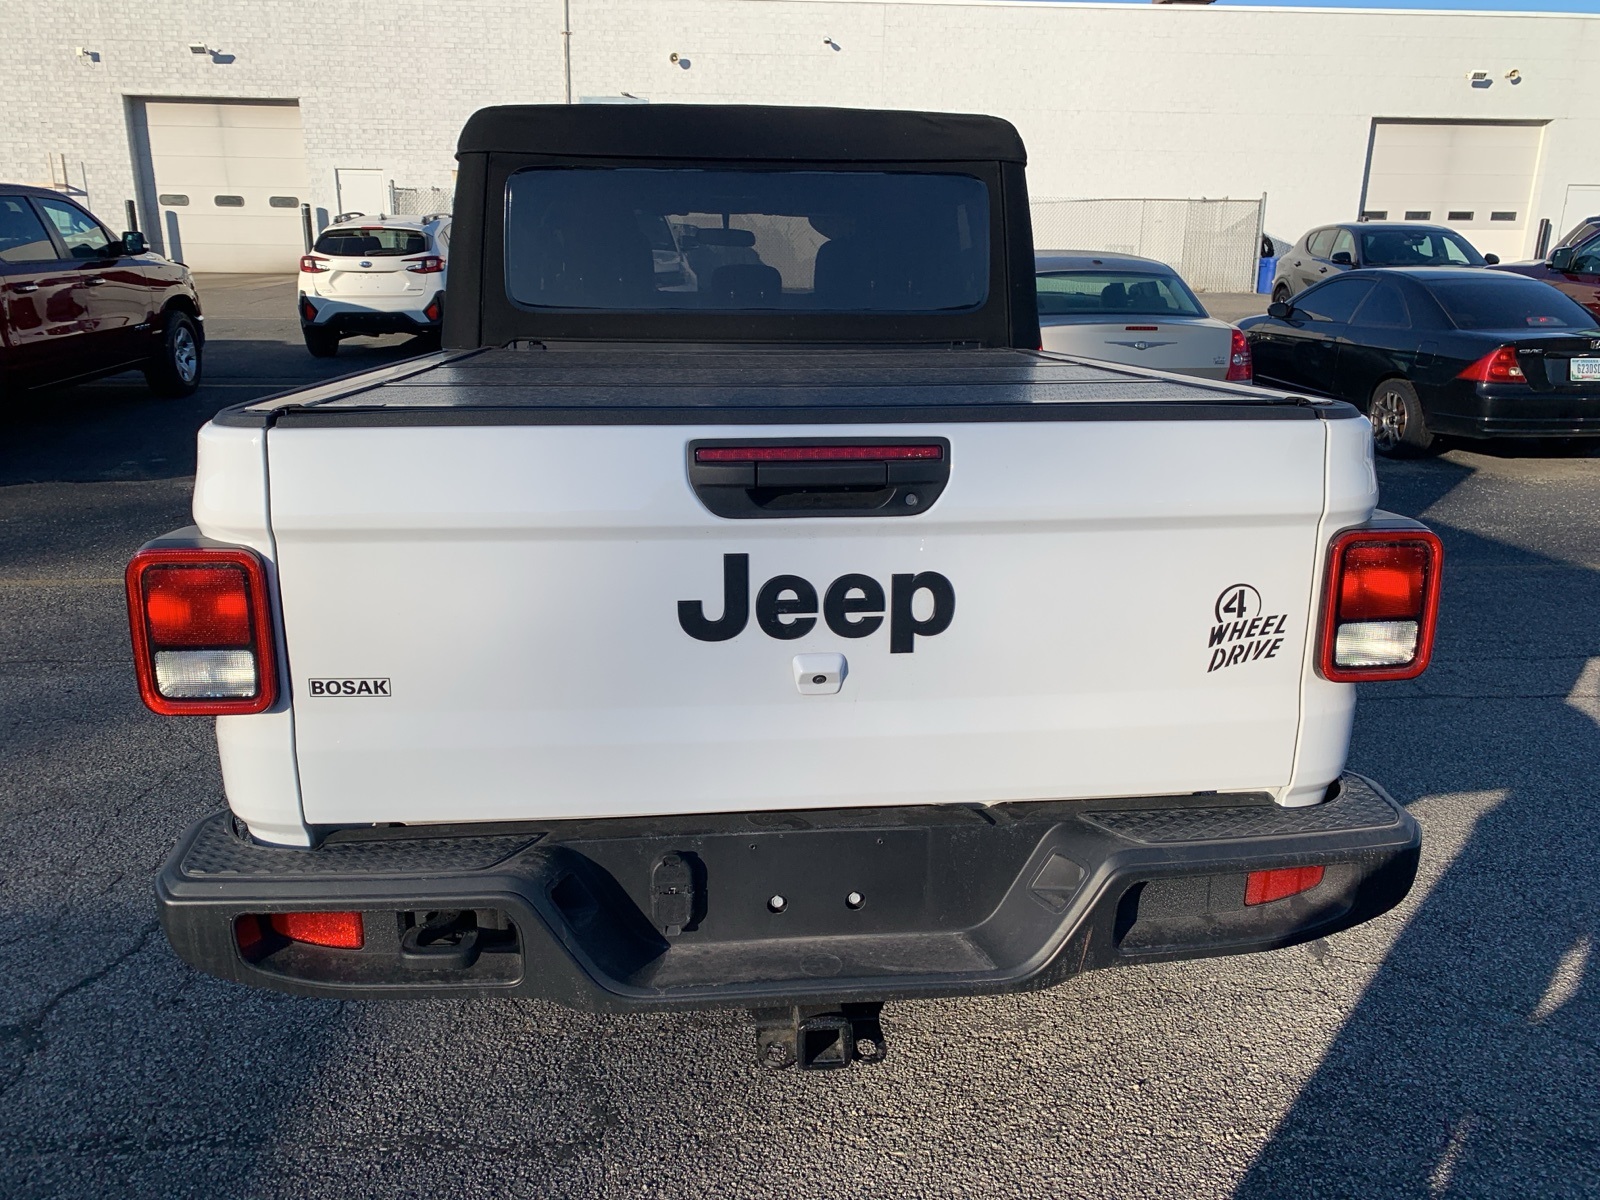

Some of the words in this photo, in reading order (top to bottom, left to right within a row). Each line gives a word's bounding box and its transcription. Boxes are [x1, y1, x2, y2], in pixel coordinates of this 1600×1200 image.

[677, 553, 956, 653] Jeep
[1222, 589, 1247, 618] 4
[1208, 614, 1288, 648] WHEEL
[1207, 638, 1285, 673] DRIVE
[311, 680, 388, 695] BOSAK
